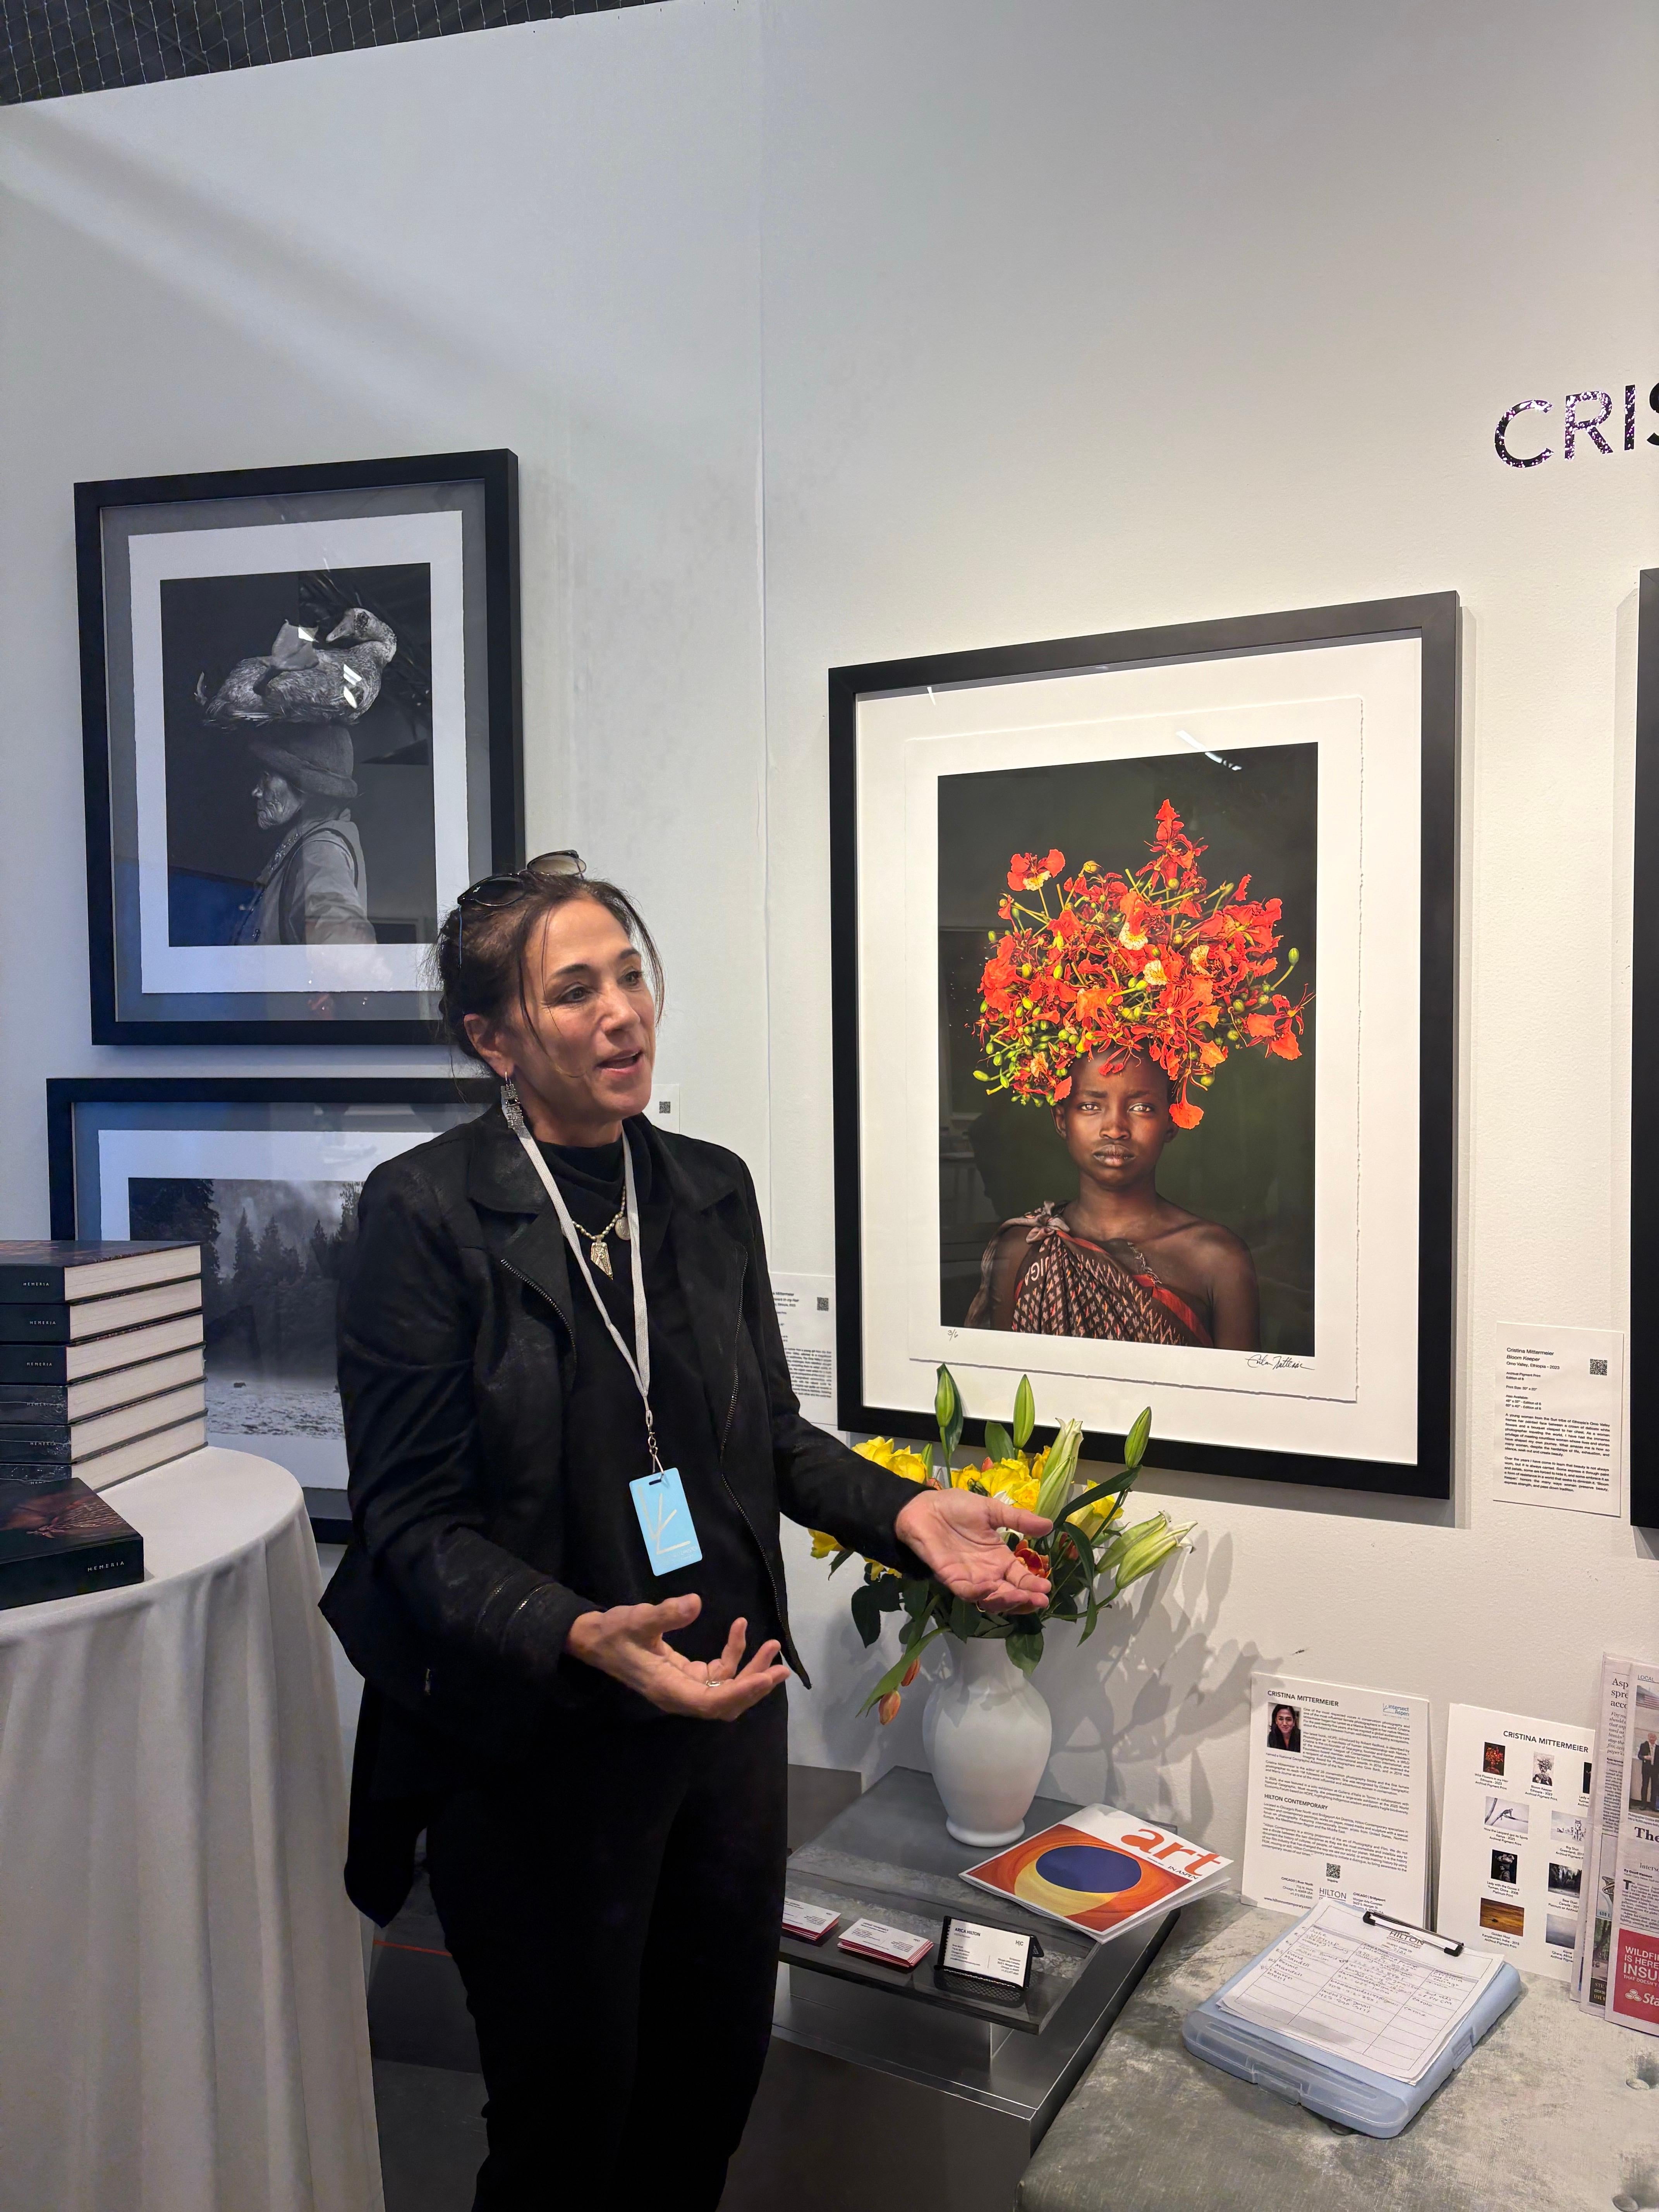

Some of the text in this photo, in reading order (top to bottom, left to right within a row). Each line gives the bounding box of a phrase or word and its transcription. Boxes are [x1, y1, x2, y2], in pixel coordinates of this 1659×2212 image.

[88, 1561, 124, 1571] HEMERIA
[1267, 1690, 1339, 1706] CRISTINA MITTERMEIER
[1503, 1730, 1588, 1753] CRISTINA MITTERMEIER
[1284, 1798, 1328, 1810] CONTEMPORARY
[1635, 1827, 1659, 1843] The
[1121, 1829, 1221, 1876] art
[1178, 1870, 1199, 1879] ASPEN
[1319, 1887, 1346, 1899] HILTON
[1389, 1931, 1424, 1946] HILTON
[1635, 1957, 1659, 1970] HERE
[1624, 1963, 1659, 1982] INSU
